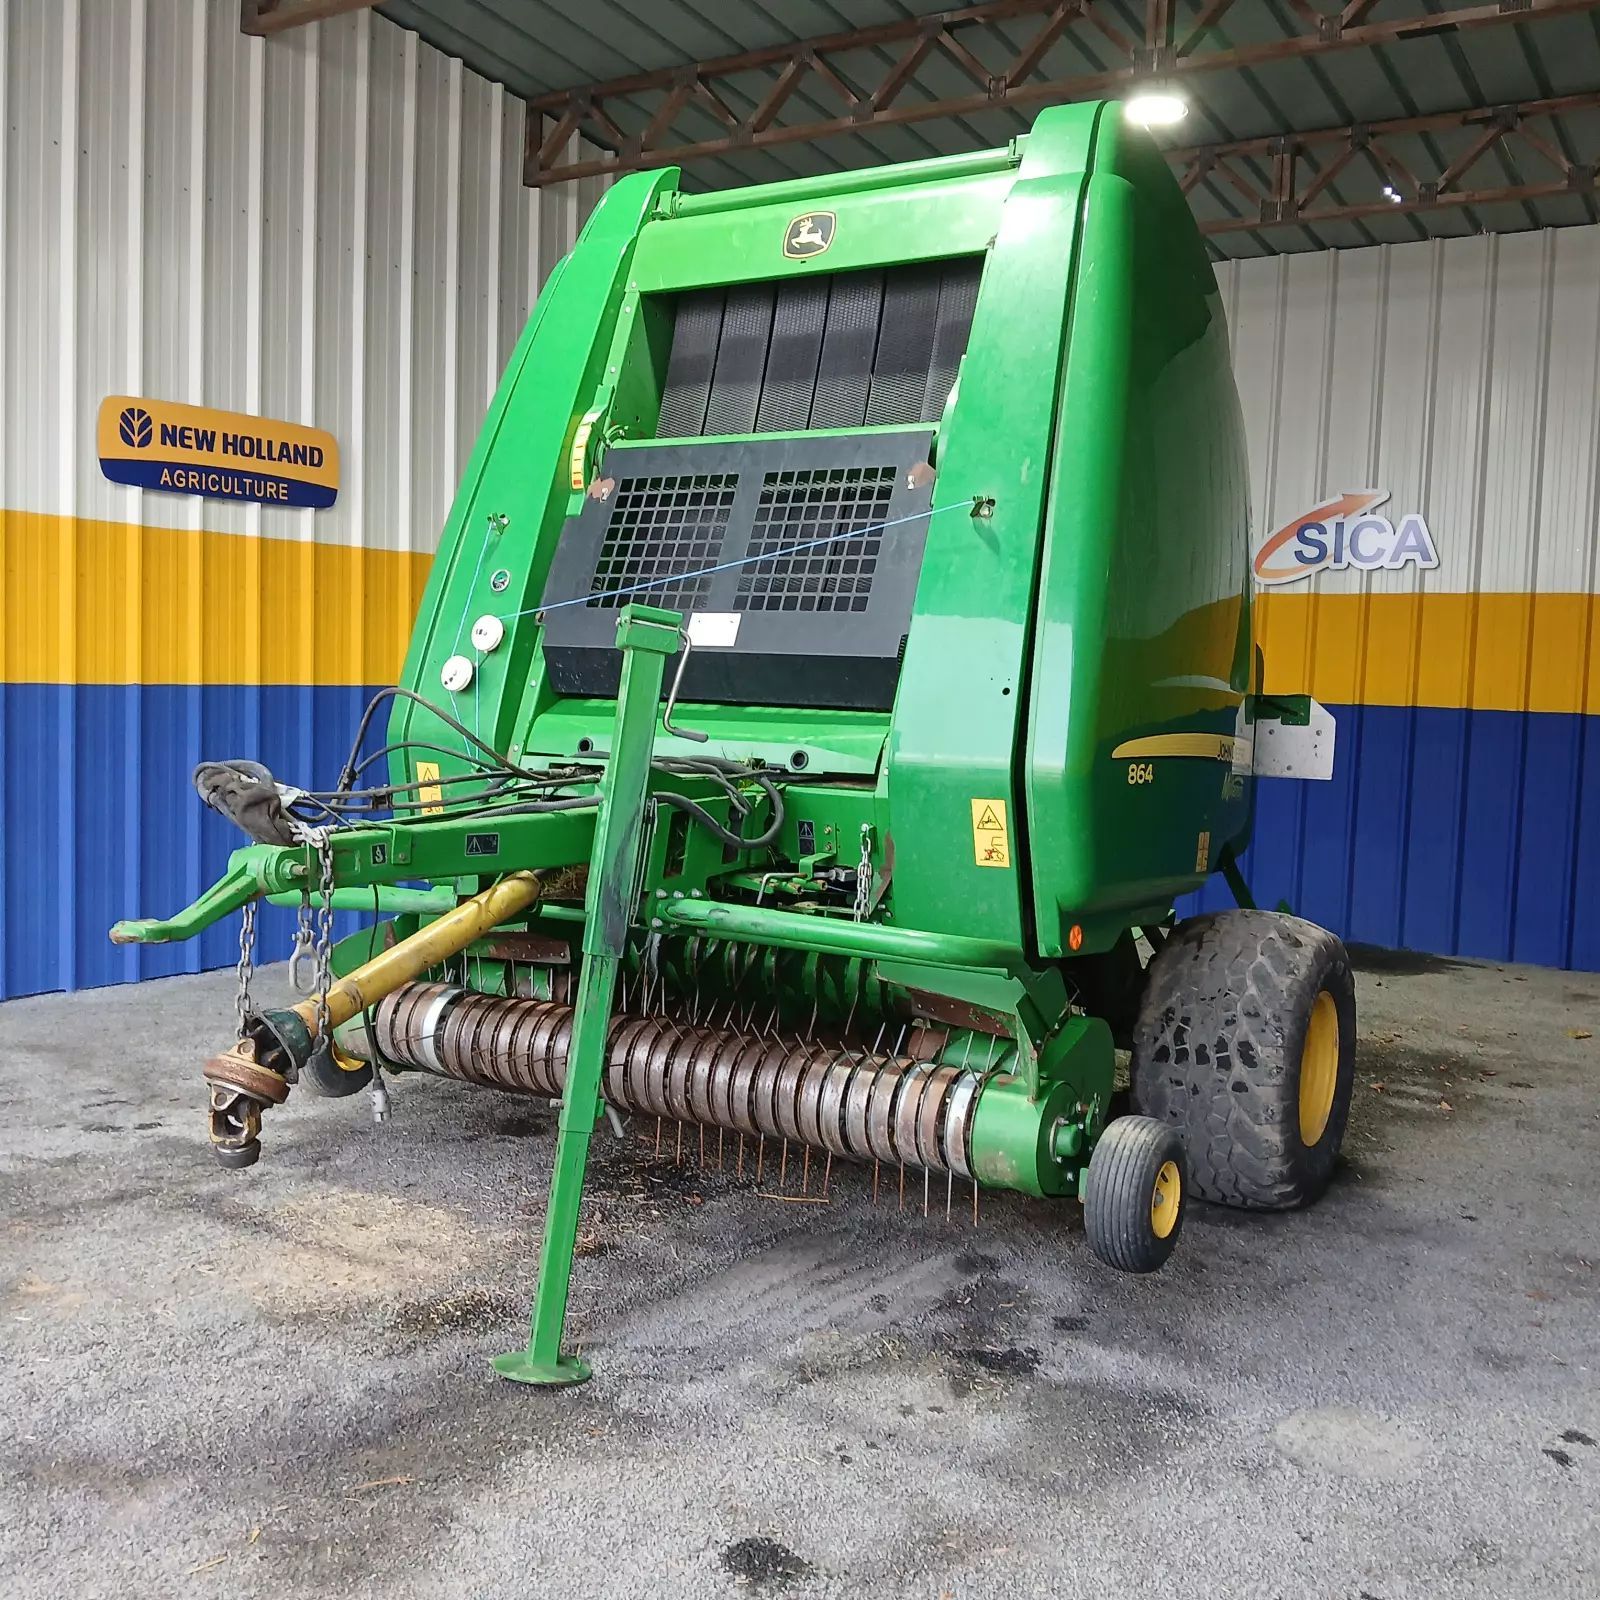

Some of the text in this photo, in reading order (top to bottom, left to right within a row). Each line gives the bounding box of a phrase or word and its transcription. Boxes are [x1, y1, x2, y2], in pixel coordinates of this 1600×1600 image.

[160, 423, 324, 468] NEW HOLLAND
[160, 468, 289, 500] AGRICULTURE
[1294, 519, 1433, 565] SICA
[1127, 763, 1154, 785] 864
